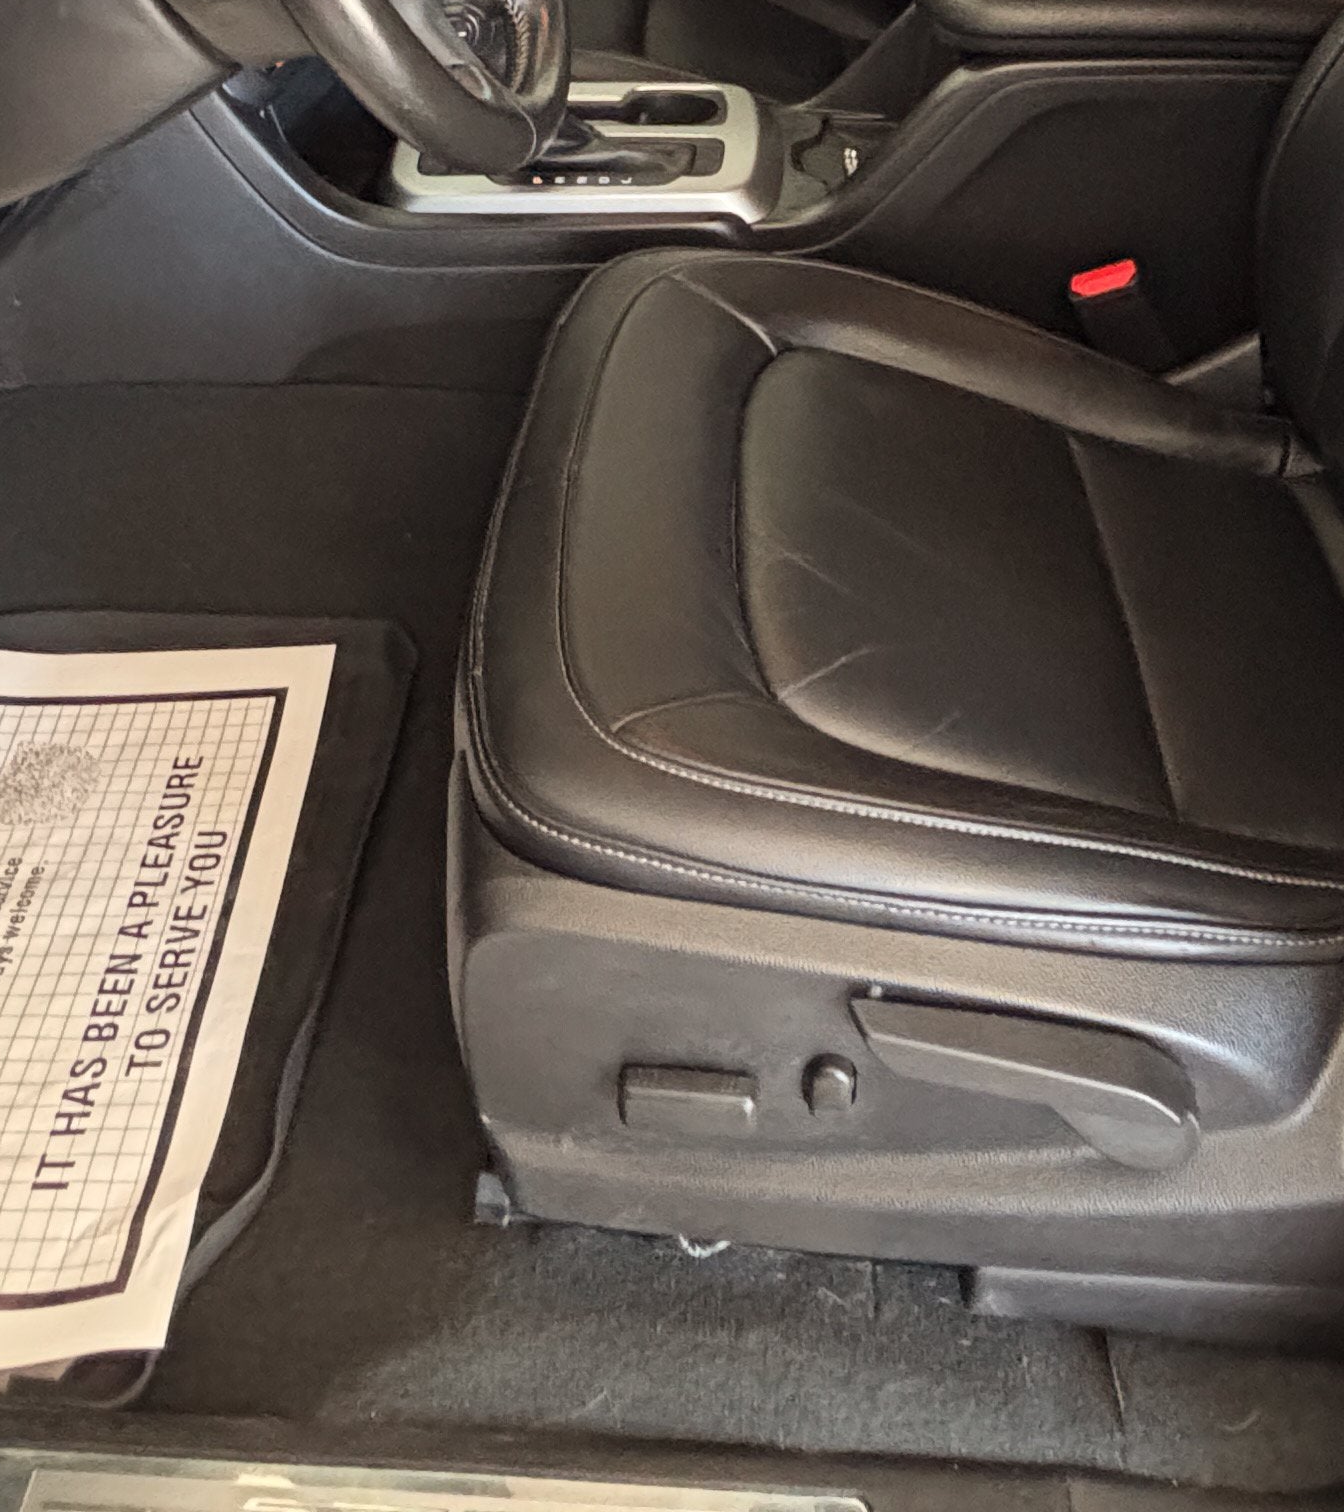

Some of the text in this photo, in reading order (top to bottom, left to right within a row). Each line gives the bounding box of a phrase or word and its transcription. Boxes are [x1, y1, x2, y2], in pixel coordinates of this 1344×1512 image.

[31, 755, 204, 1191] IT HAS BEEN A PLEASURE
[125, 830, 228, 1077] TO SERVE YOU
